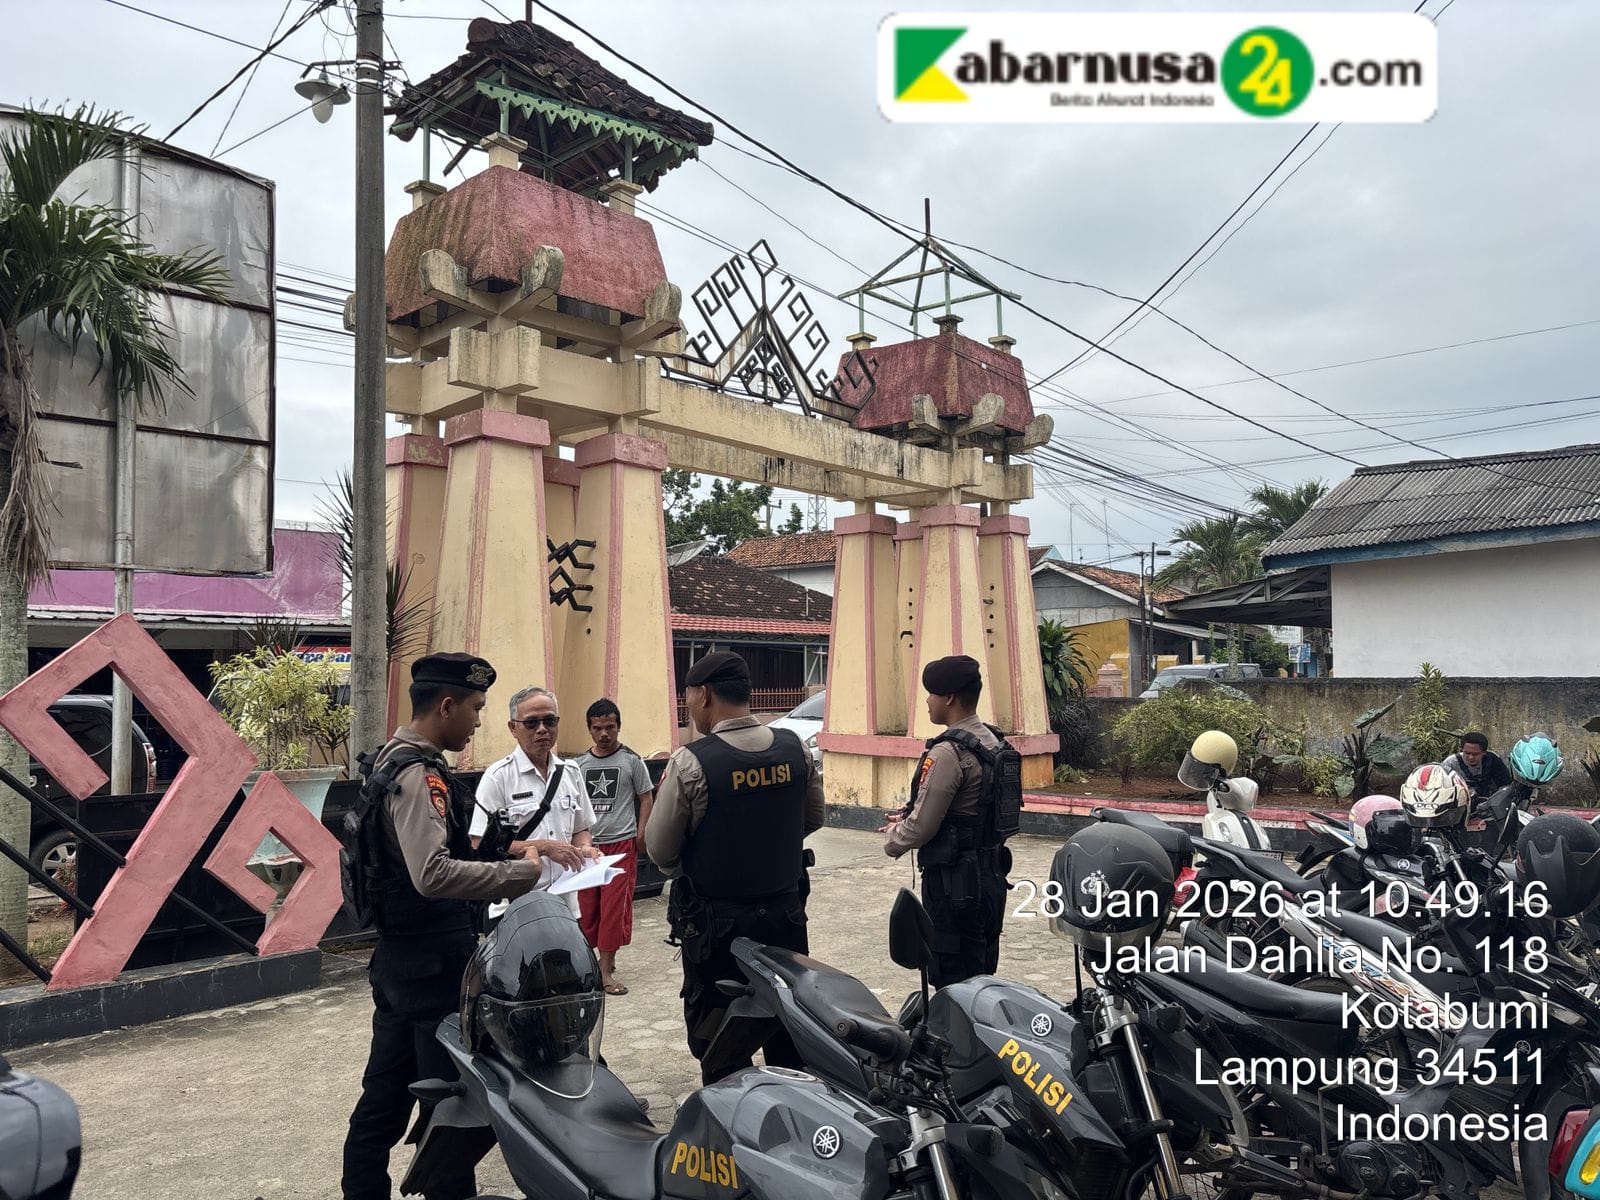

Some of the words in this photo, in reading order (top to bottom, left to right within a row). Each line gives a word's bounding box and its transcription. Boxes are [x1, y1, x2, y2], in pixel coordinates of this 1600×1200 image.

[731, 763, 792, 791] POLISI
[998, 1038, 1073, 1115] POLISI
[671, 1142, 739, 1189] POLISI
